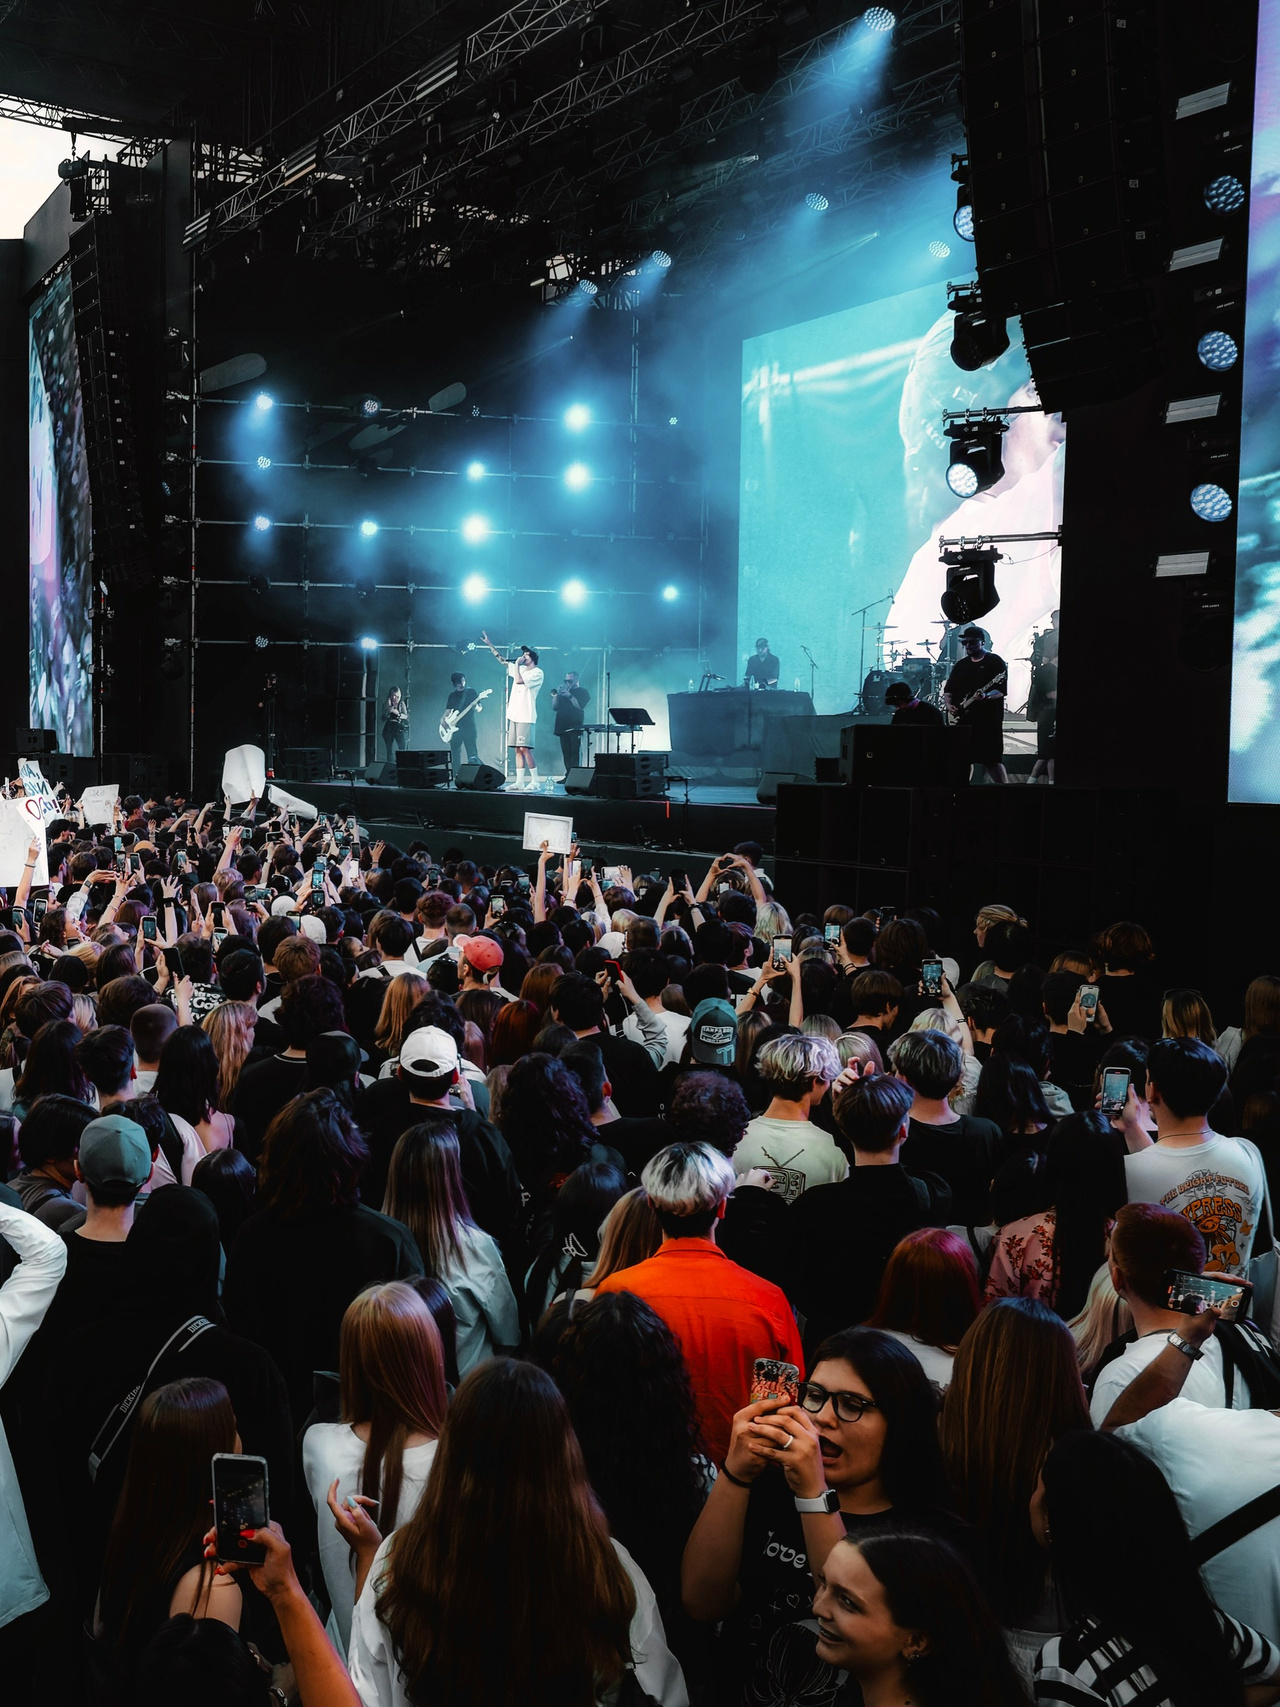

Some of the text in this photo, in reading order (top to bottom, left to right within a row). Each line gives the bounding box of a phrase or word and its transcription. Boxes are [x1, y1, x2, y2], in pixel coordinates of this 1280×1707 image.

[1177, 1175, 1213, 1195] BRIGHT
[1179, 1196, 1242, 1223] YPRESS
[763, 1531, 806, 1569] love
